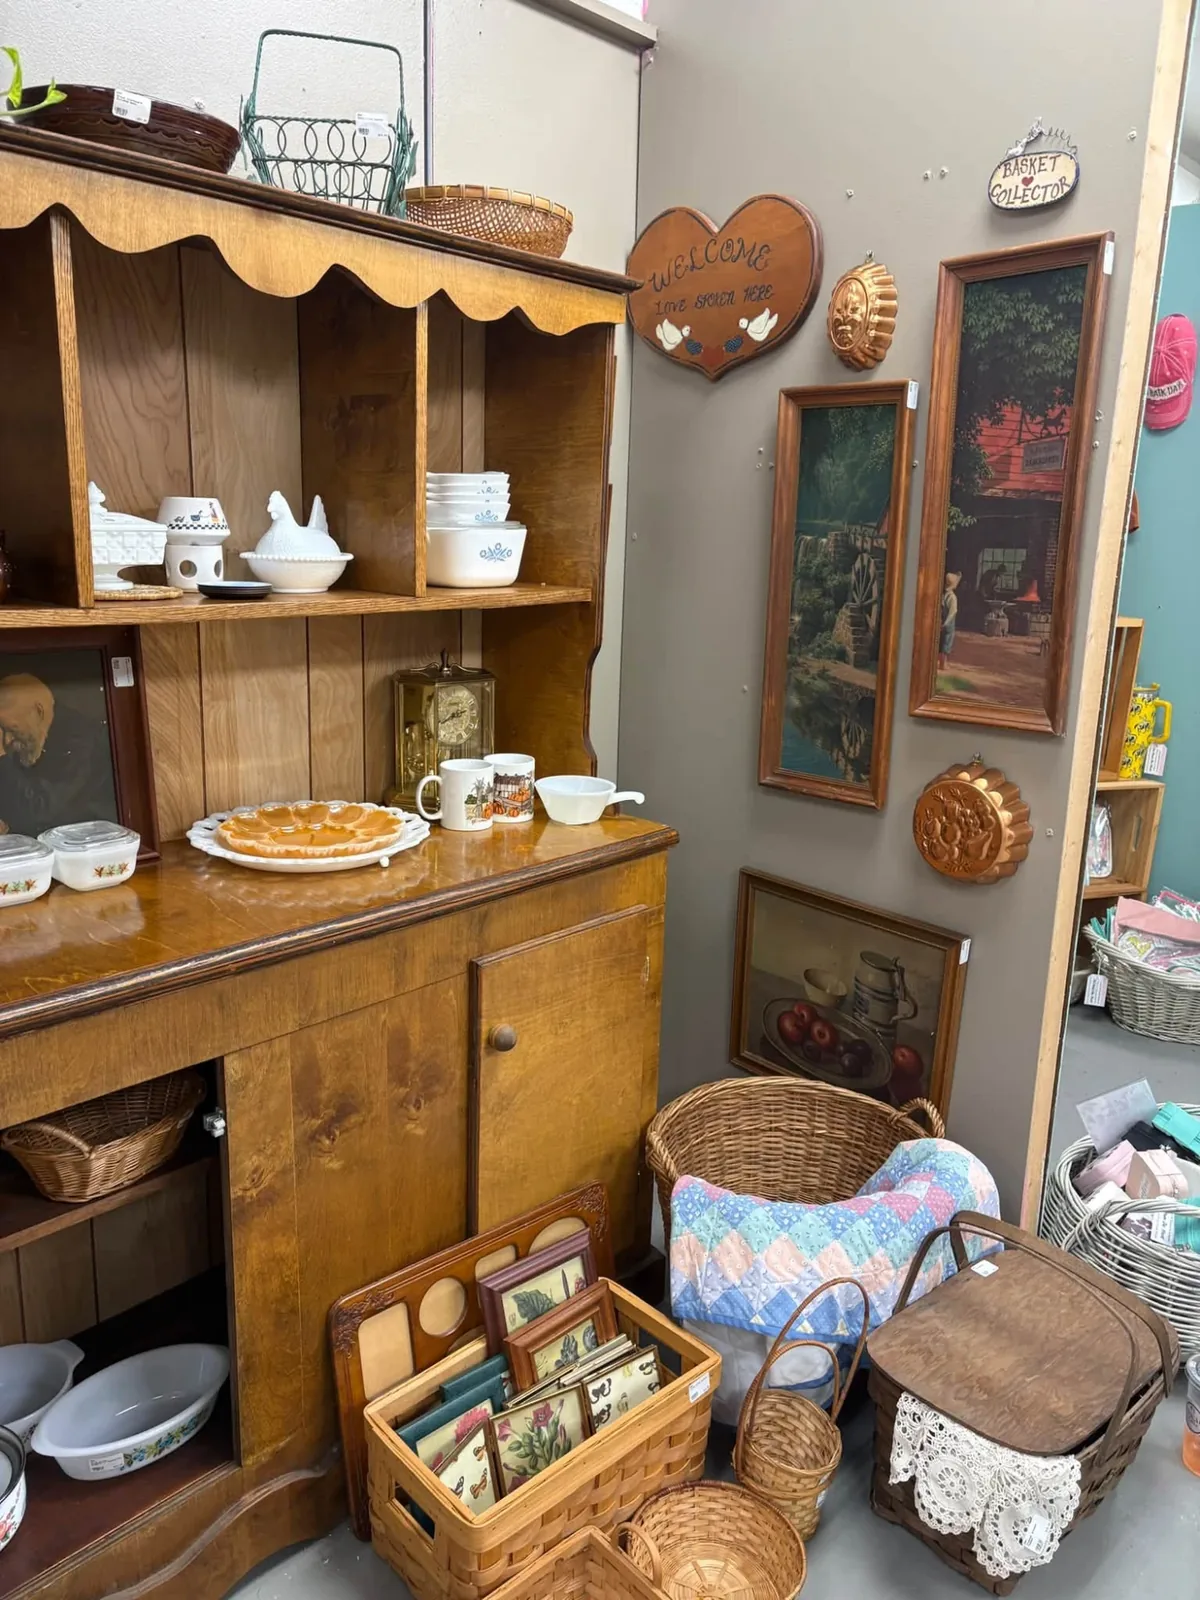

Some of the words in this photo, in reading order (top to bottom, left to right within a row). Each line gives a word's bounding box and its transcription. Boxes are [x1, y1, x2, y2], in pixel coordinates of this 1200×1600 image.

[1002, 153, 1061, 179] BASKET
[990, 175, 1070, 205] COLLECTOR
[649, 237, 772, 293] WELCOME
[655, 299, 687, 316] LOVE
[694, 290, 736, 310] SPOKEN
[743, 284, 775, 301] HERE
